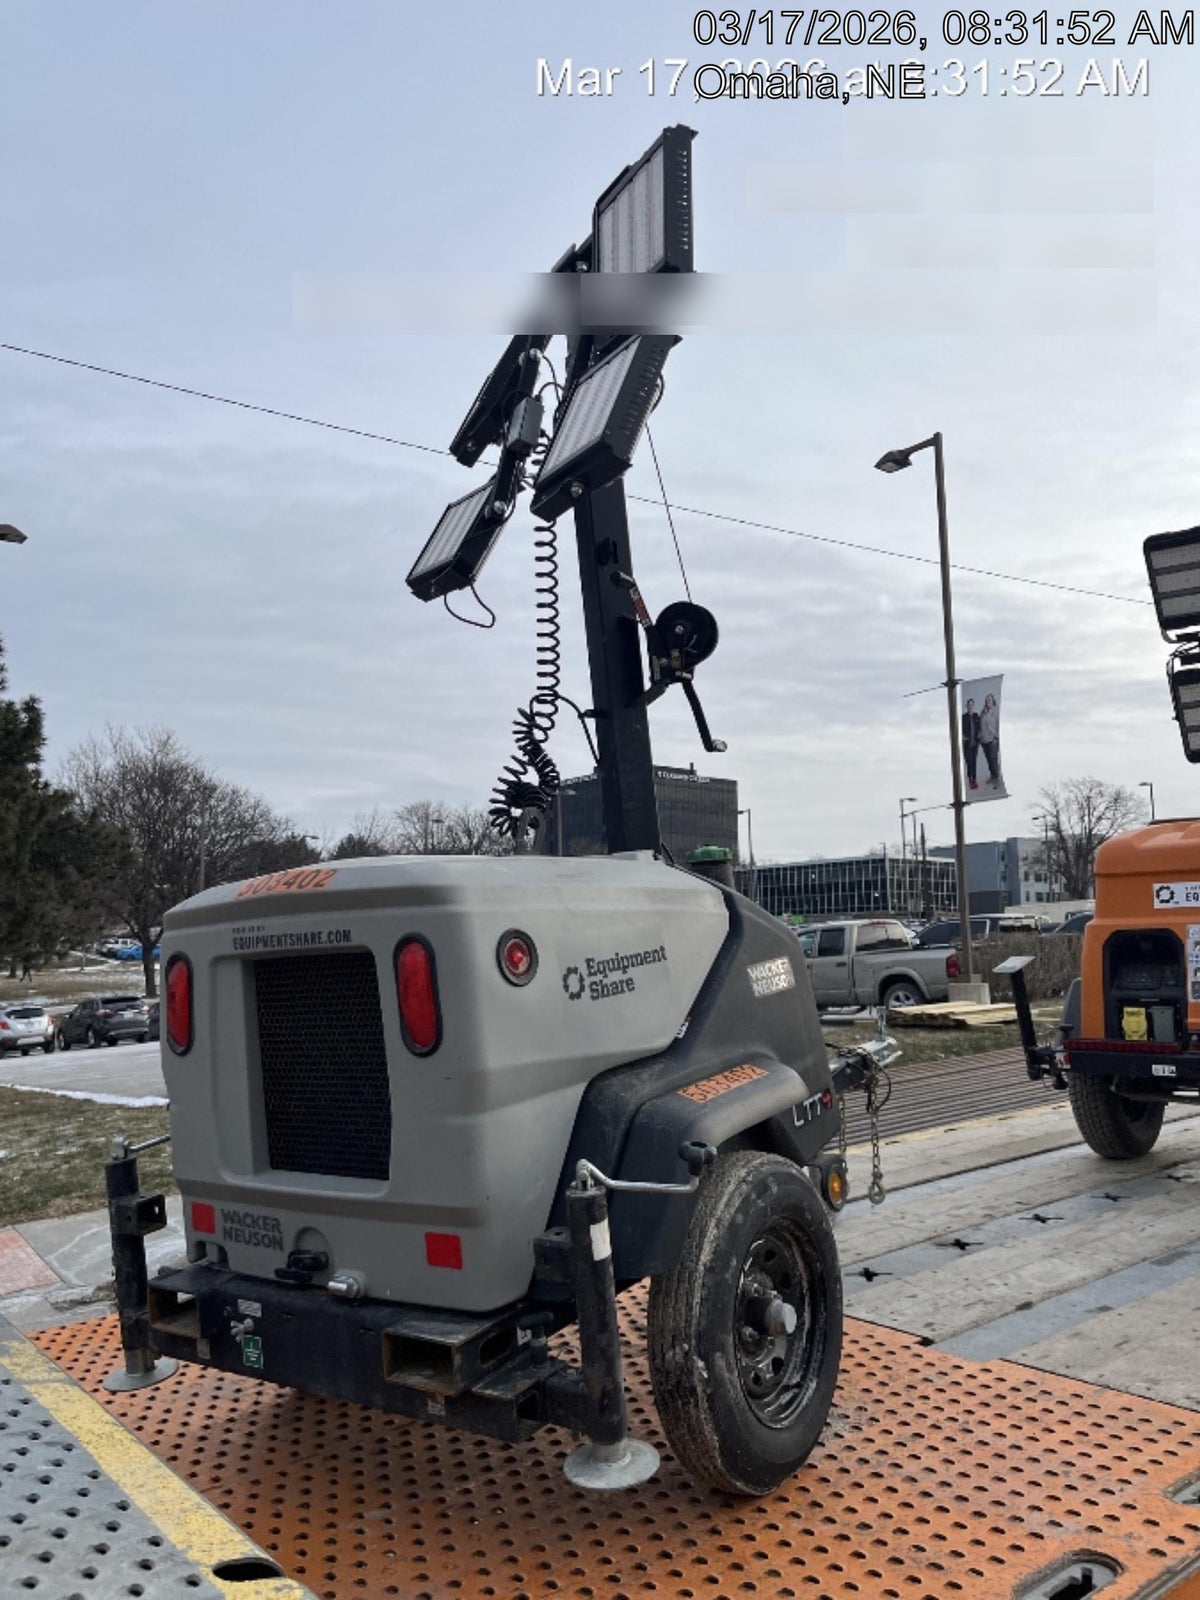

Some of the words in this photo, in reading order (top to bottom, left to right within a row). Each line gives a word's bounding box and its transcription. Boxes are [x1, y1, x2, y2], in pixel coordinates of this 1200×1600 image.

[237, 868, 338, 897] 503402
[232, 929, 353, 950] EQUIPMENTSHARE.COM
[584, 945, 667, 979] Equipment
[589, 976, 635, 1001] Share
[220, 1207, 283, 1234] WACKER
[222, 1223, 285, 1252] NEUSON
